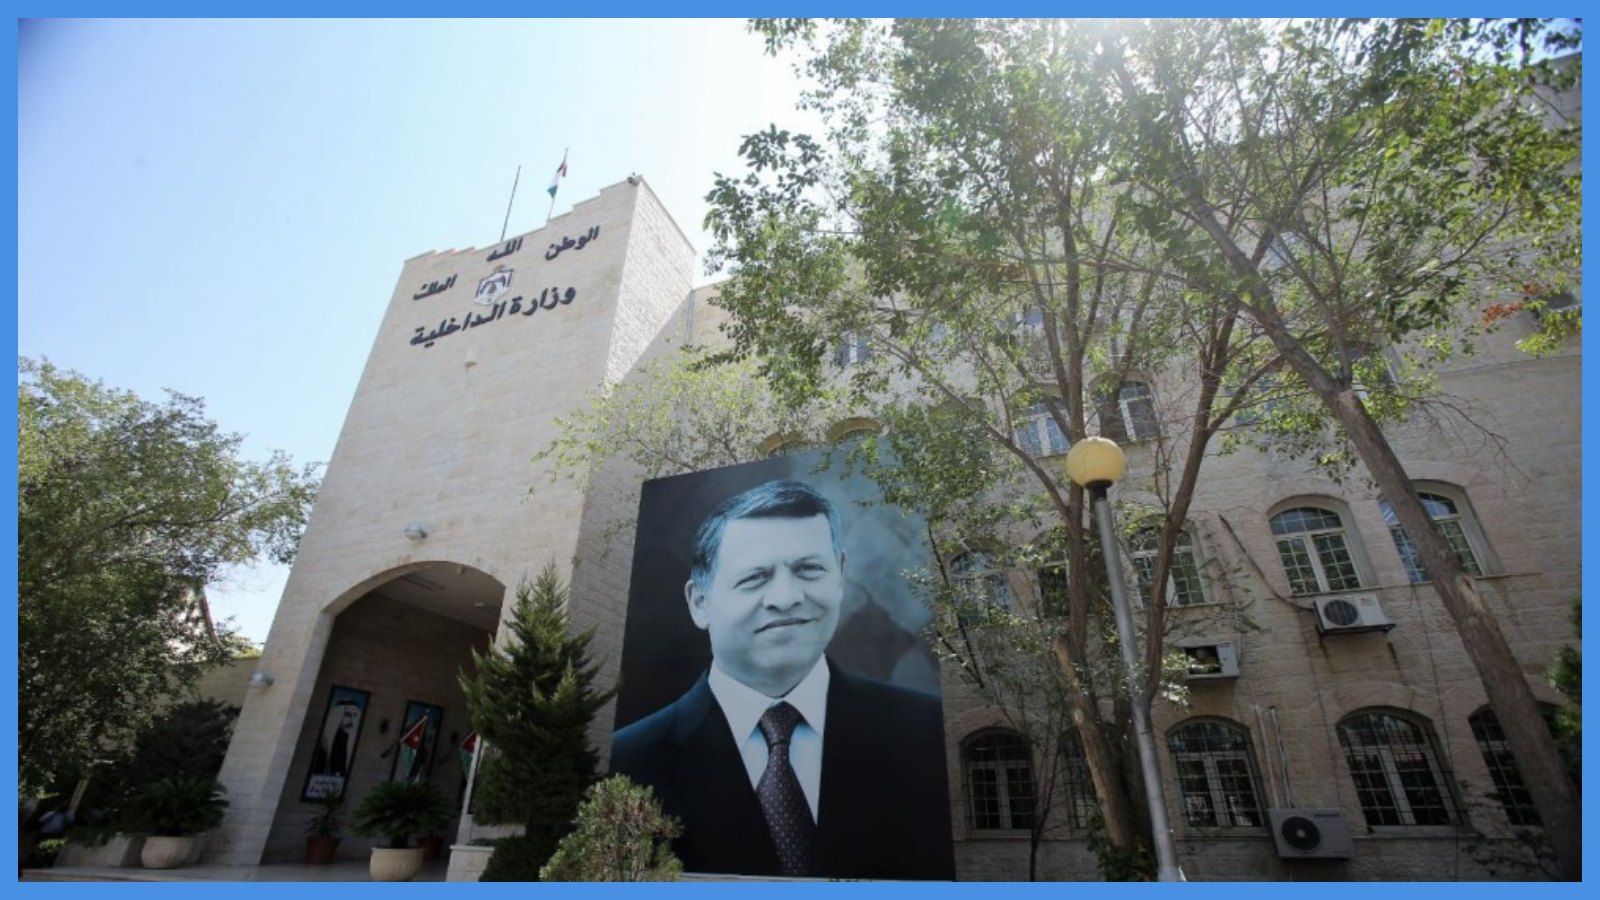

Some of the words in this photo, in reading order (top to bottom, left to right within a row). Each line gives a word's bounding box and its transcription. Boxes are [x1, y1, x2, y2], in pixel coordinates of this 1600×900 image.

[486, 236, 524, 262] الله
[545, 225, 600, 261] الوطن
[413, 273, 458, 300] الملك
[508, 286, 577, 316] وزارة
[410, 301, 507, 348] الداخلية
